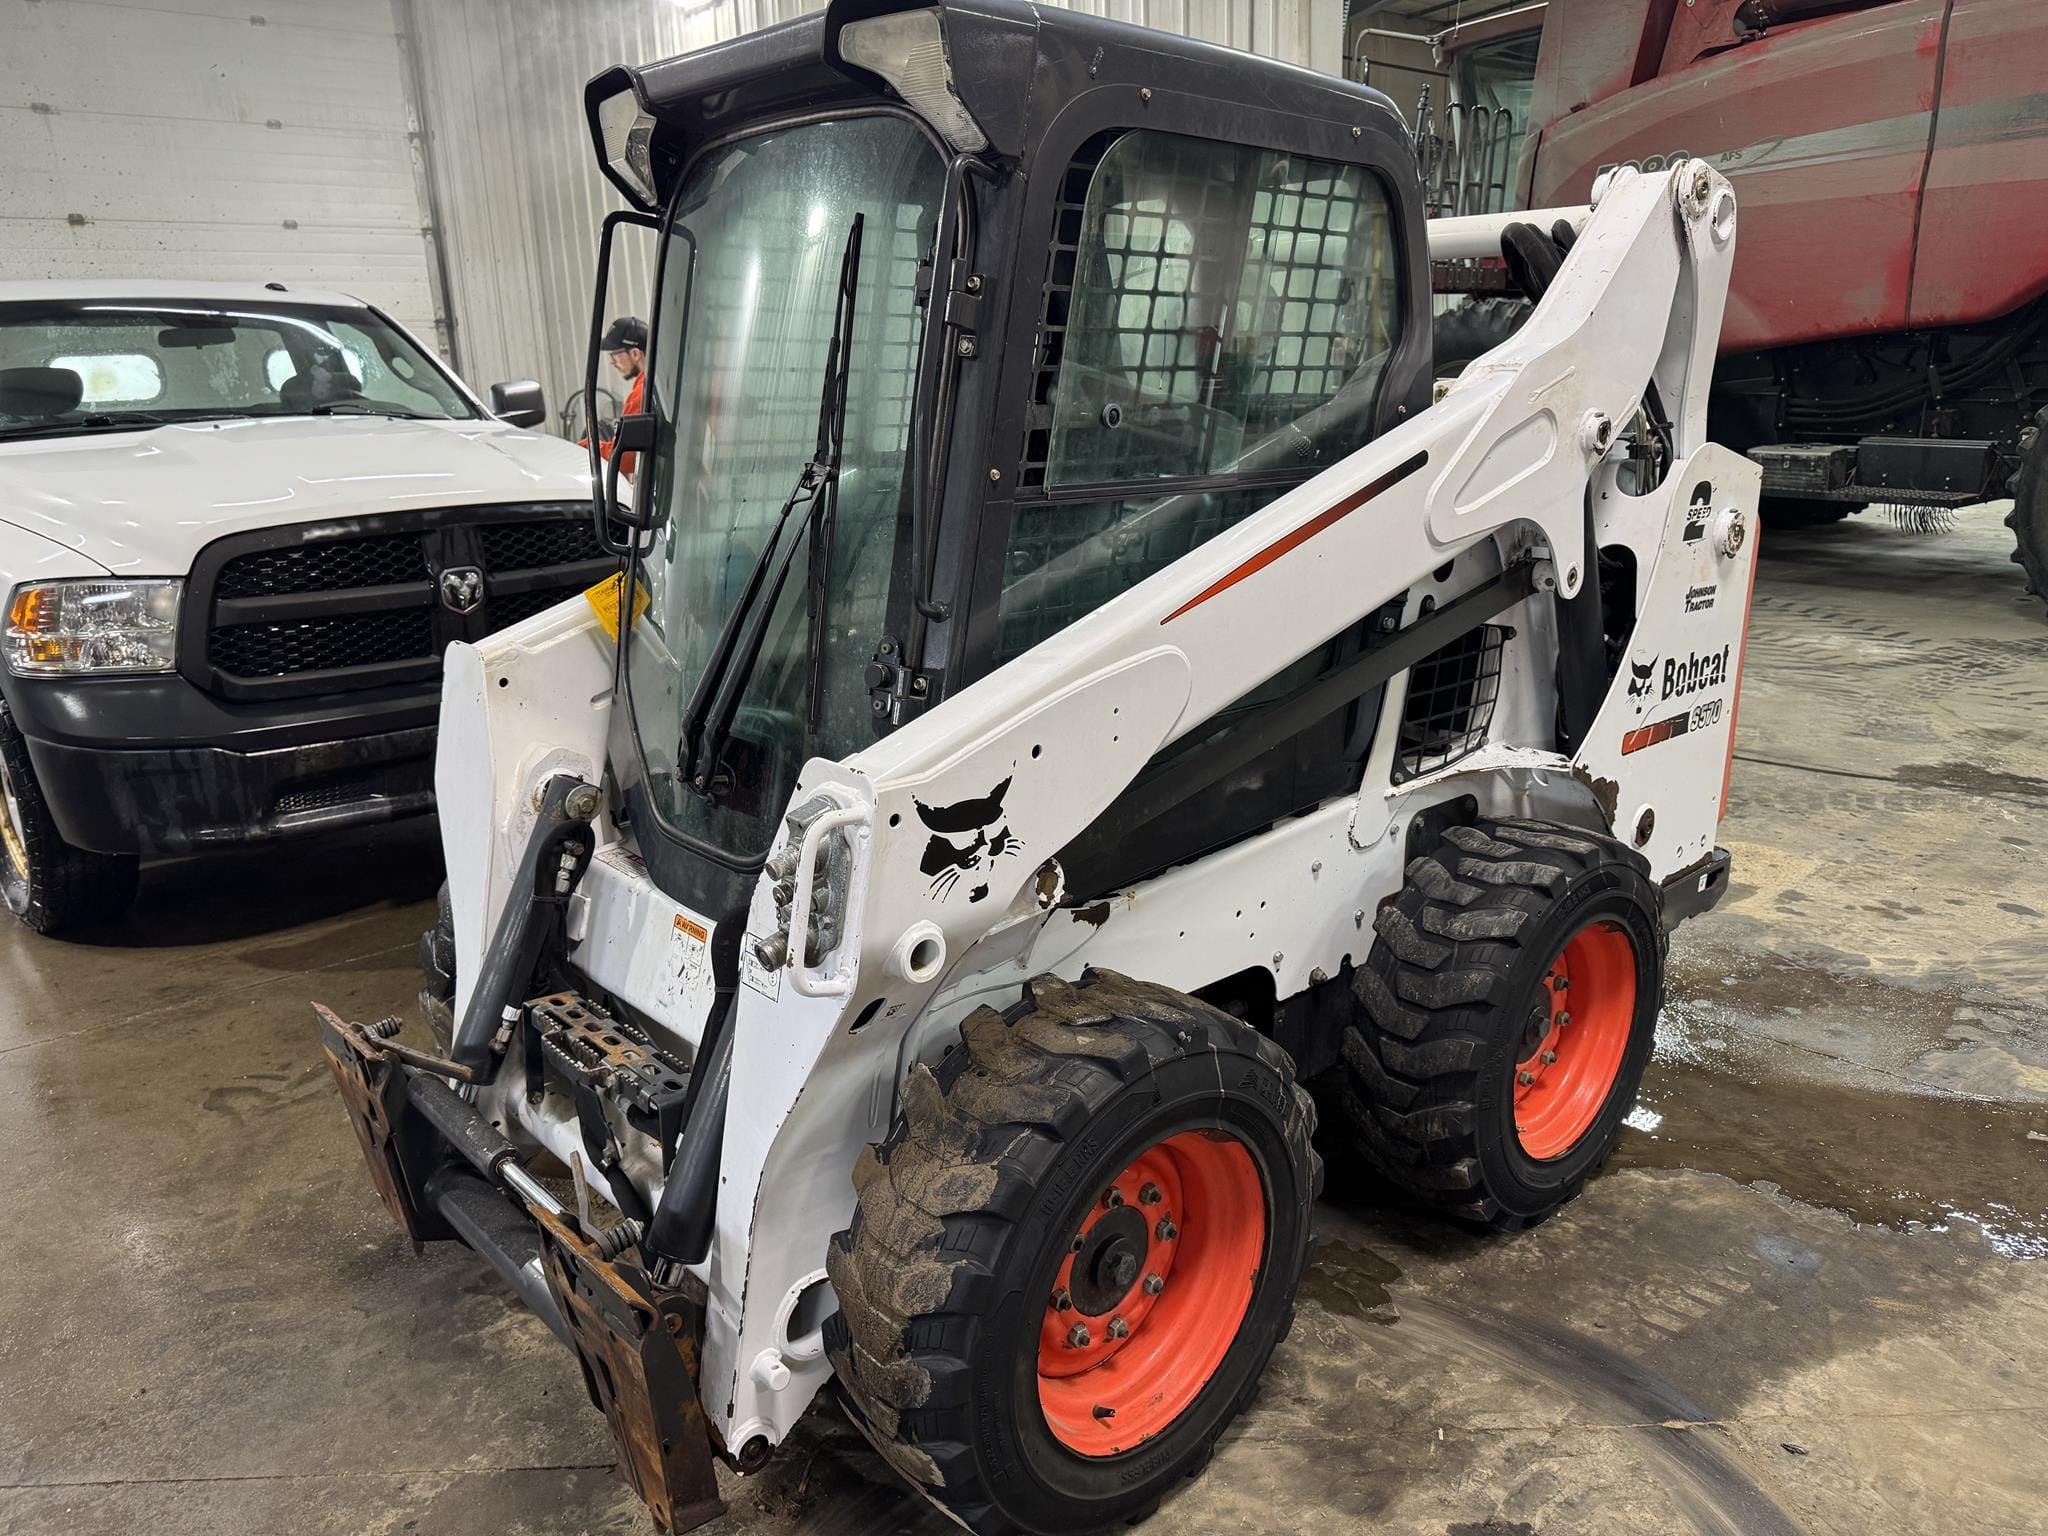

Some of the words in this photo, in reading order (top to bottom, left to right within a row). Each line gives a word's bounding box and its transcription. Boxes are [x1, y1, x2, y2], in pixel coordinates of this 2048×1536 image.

[1720, 150, 1743, 163] AFS
[1686, 505, 1712, 521] SPEED
[1685, 584, 1716, 599] JOHNSON
[1684, 598, 1715, 614] TRACTOR
[1661, 644, 1730, 702] Bobcat
[1689, 698, 1723, 732] S570
[681, 919, 705, 939] WARNING
